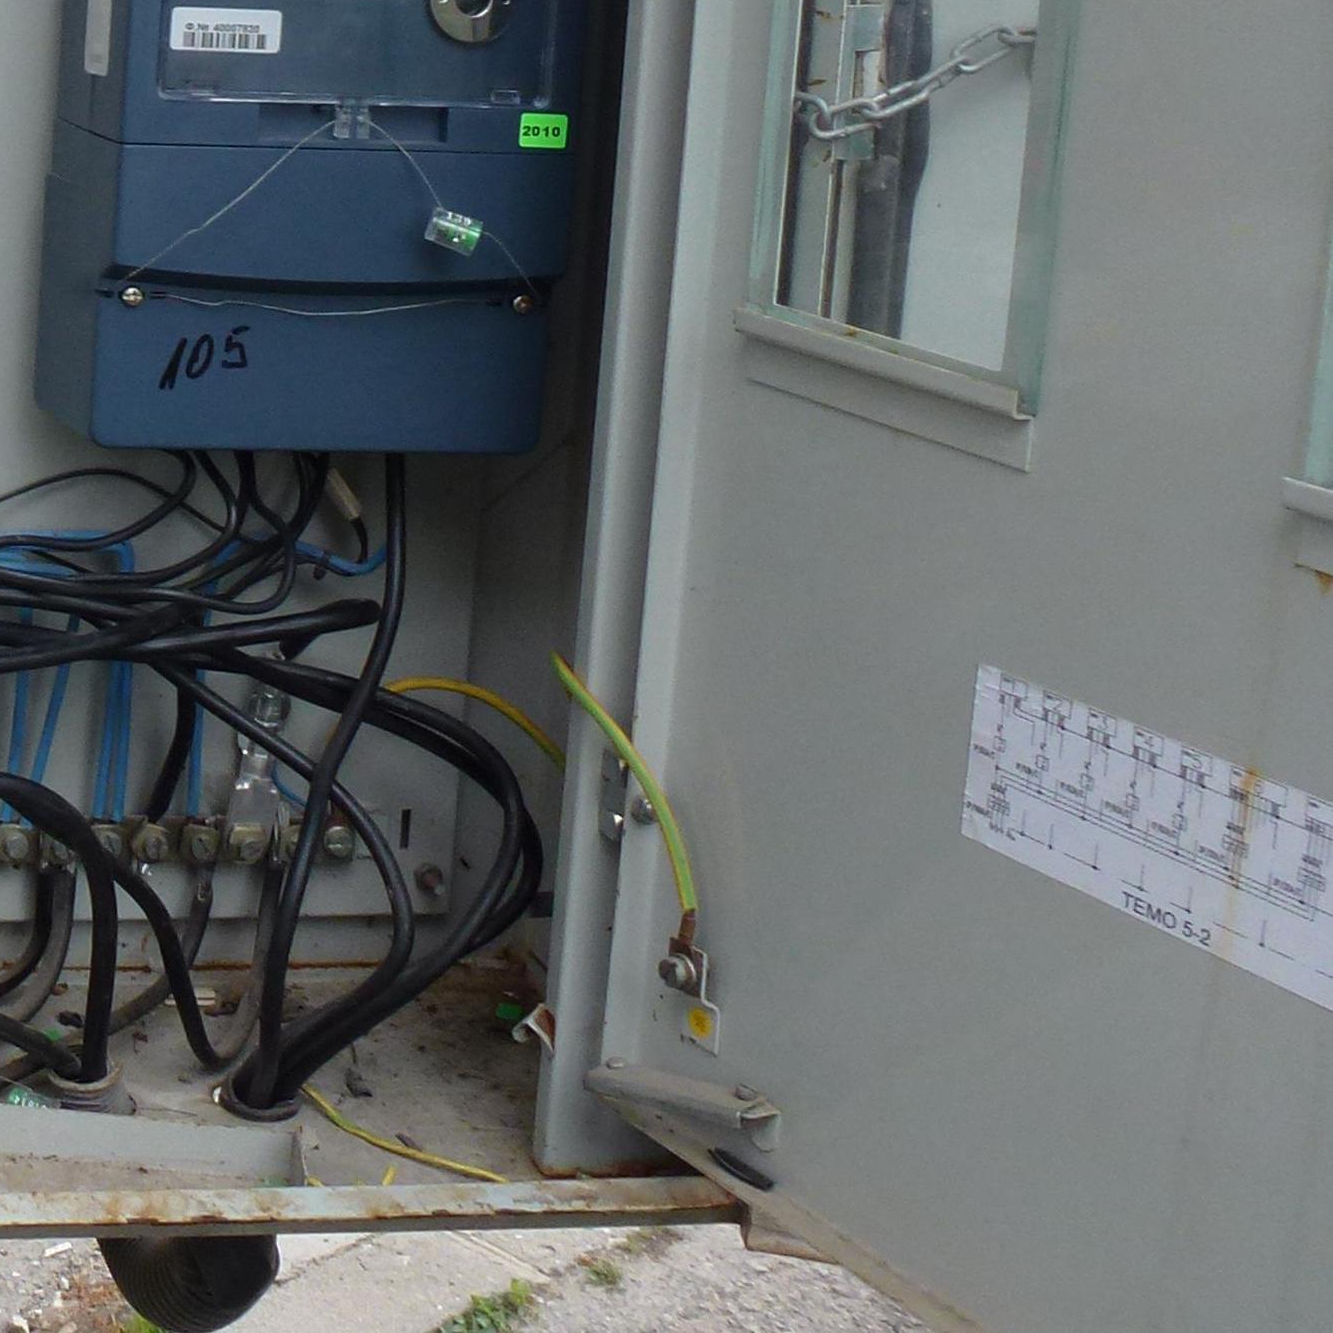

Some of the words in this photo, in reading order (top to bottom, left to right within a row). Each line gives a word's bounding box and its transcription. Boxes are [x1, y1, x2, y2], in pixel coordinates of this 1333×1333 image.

[521, 125, 562, 138] 2010
[158, 325, 250, 390] 105
[1181, 920, 1212, 947] 5-2
